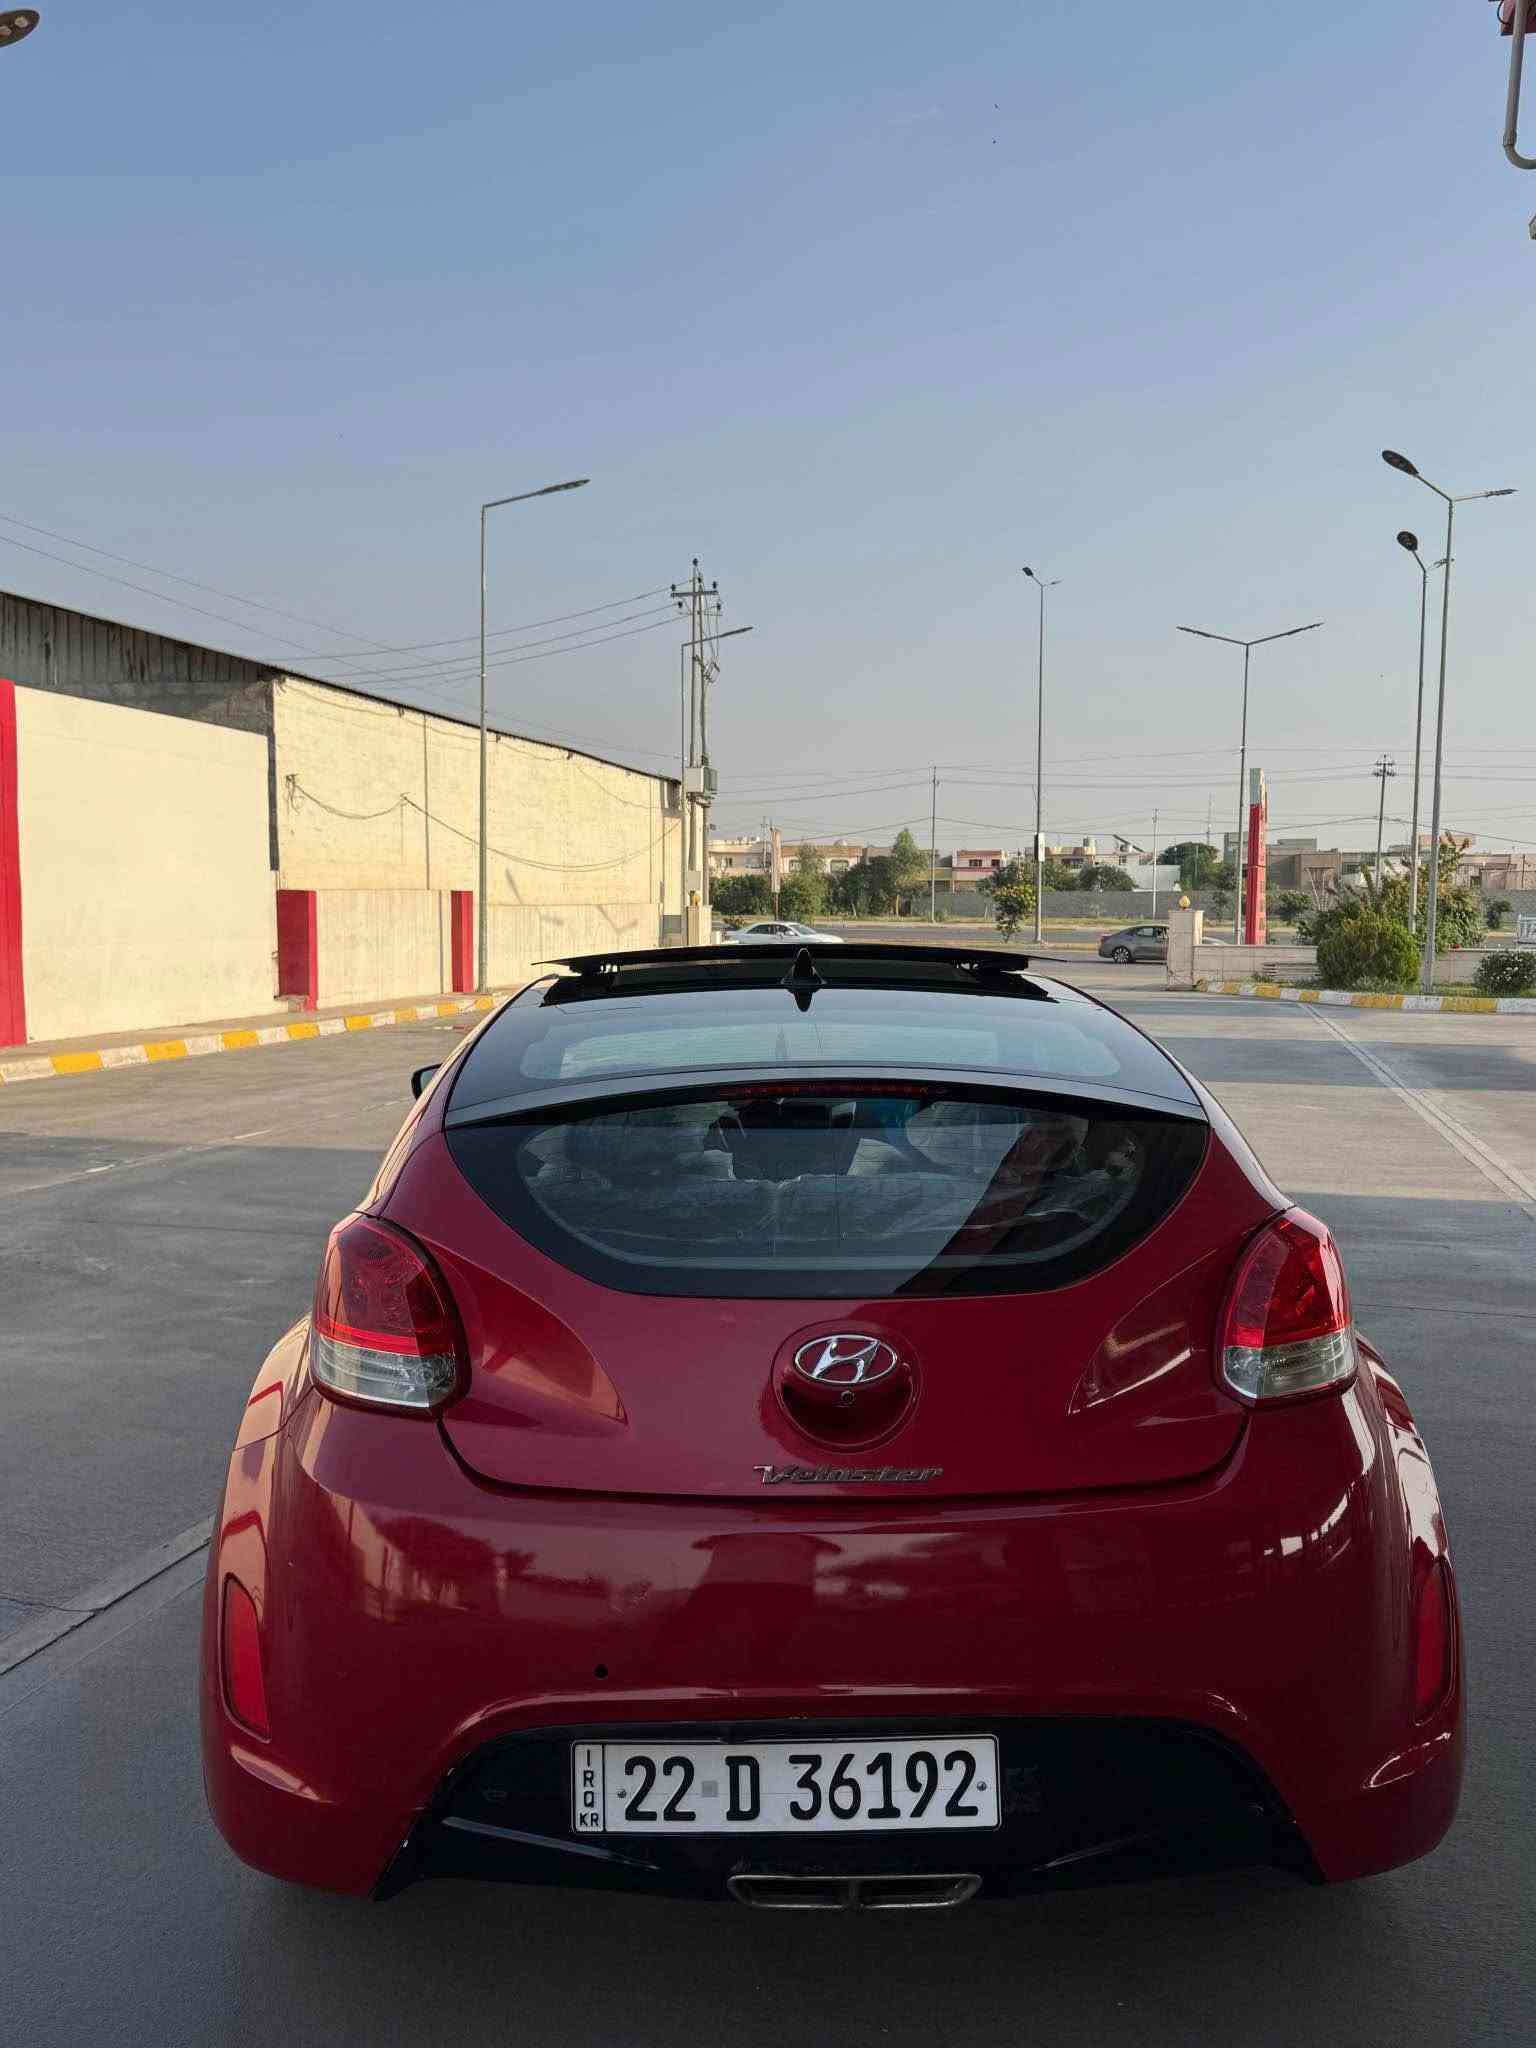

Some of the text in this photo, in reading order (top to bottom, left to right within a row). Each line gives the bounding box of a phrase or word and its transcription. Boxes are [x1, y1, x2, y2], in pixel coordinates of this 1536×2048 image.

[624, 1750, 979, 1821] 22 D 36192
